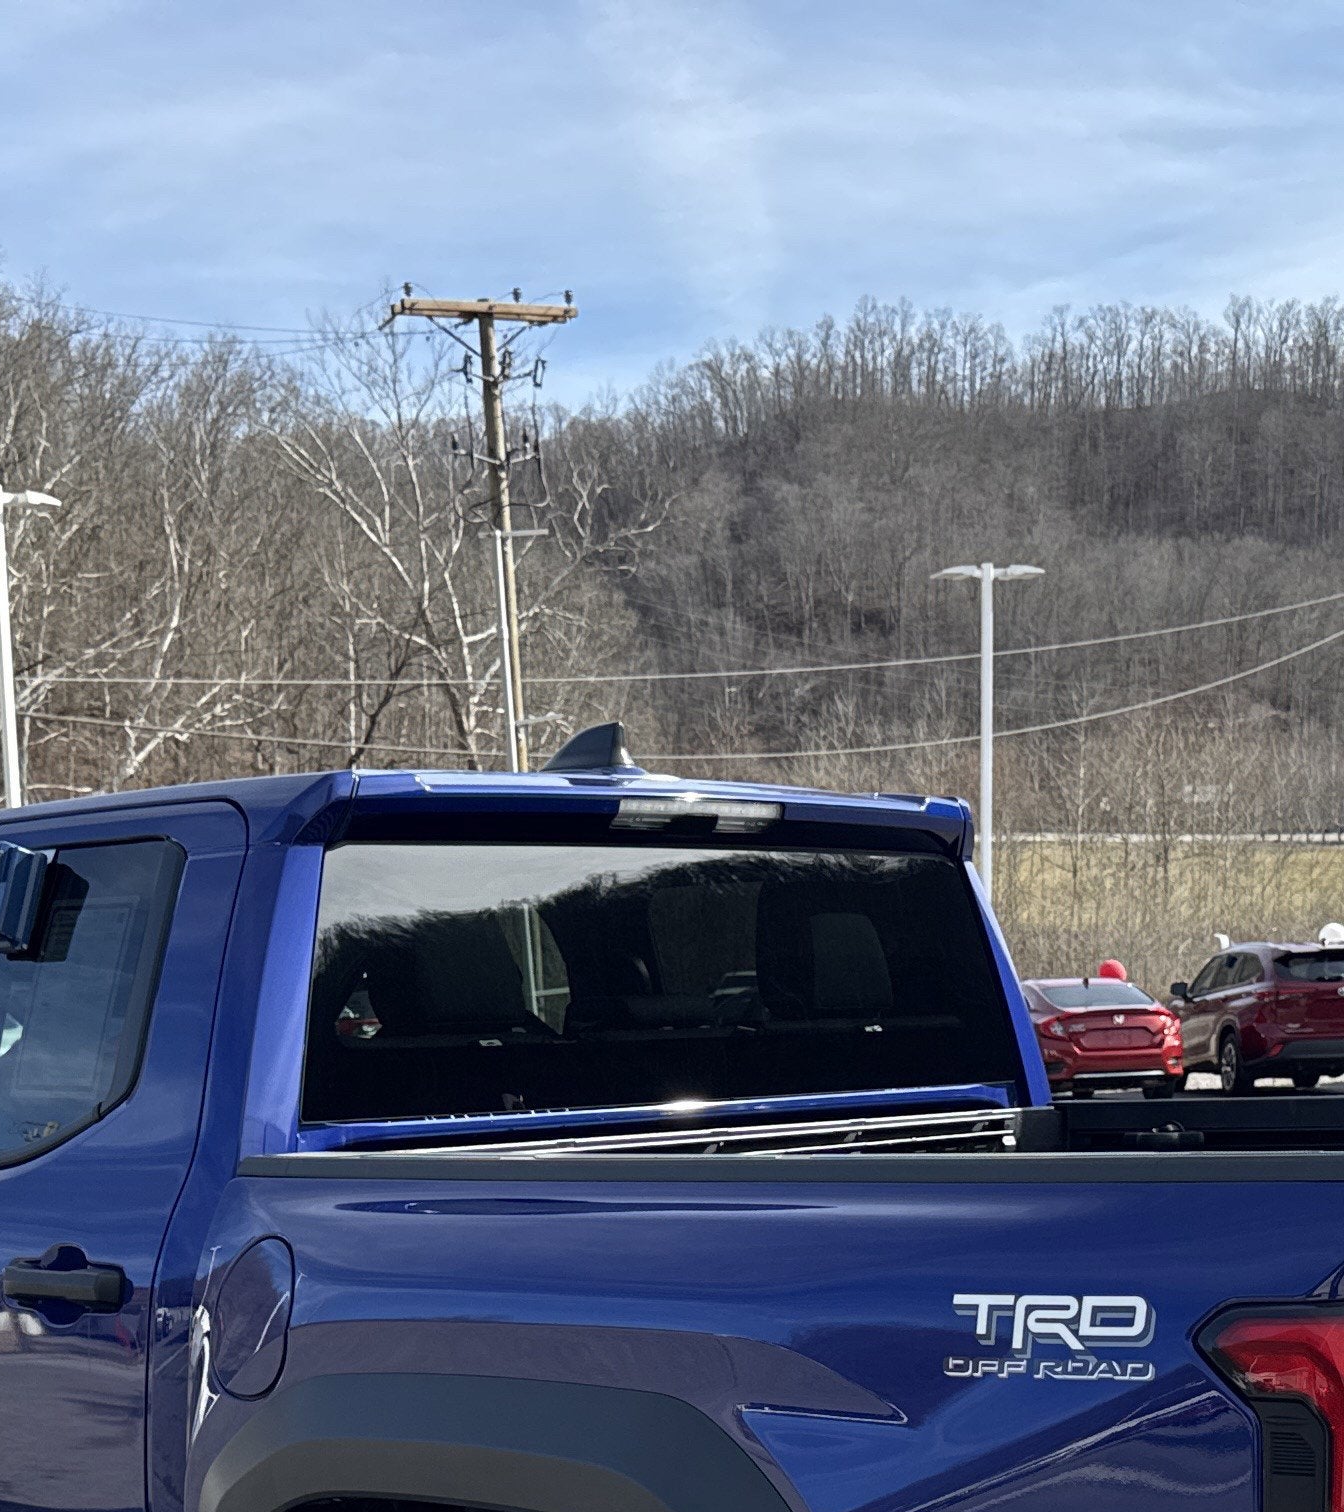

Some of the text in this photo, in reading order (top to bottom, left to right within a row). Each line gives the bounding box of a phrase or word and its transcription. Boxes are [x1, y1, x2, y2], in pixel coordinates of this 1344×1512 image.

[951, 1293, 1156, 1362] TRD
[943, 1356, 1156, 1381] OFF ROAD
